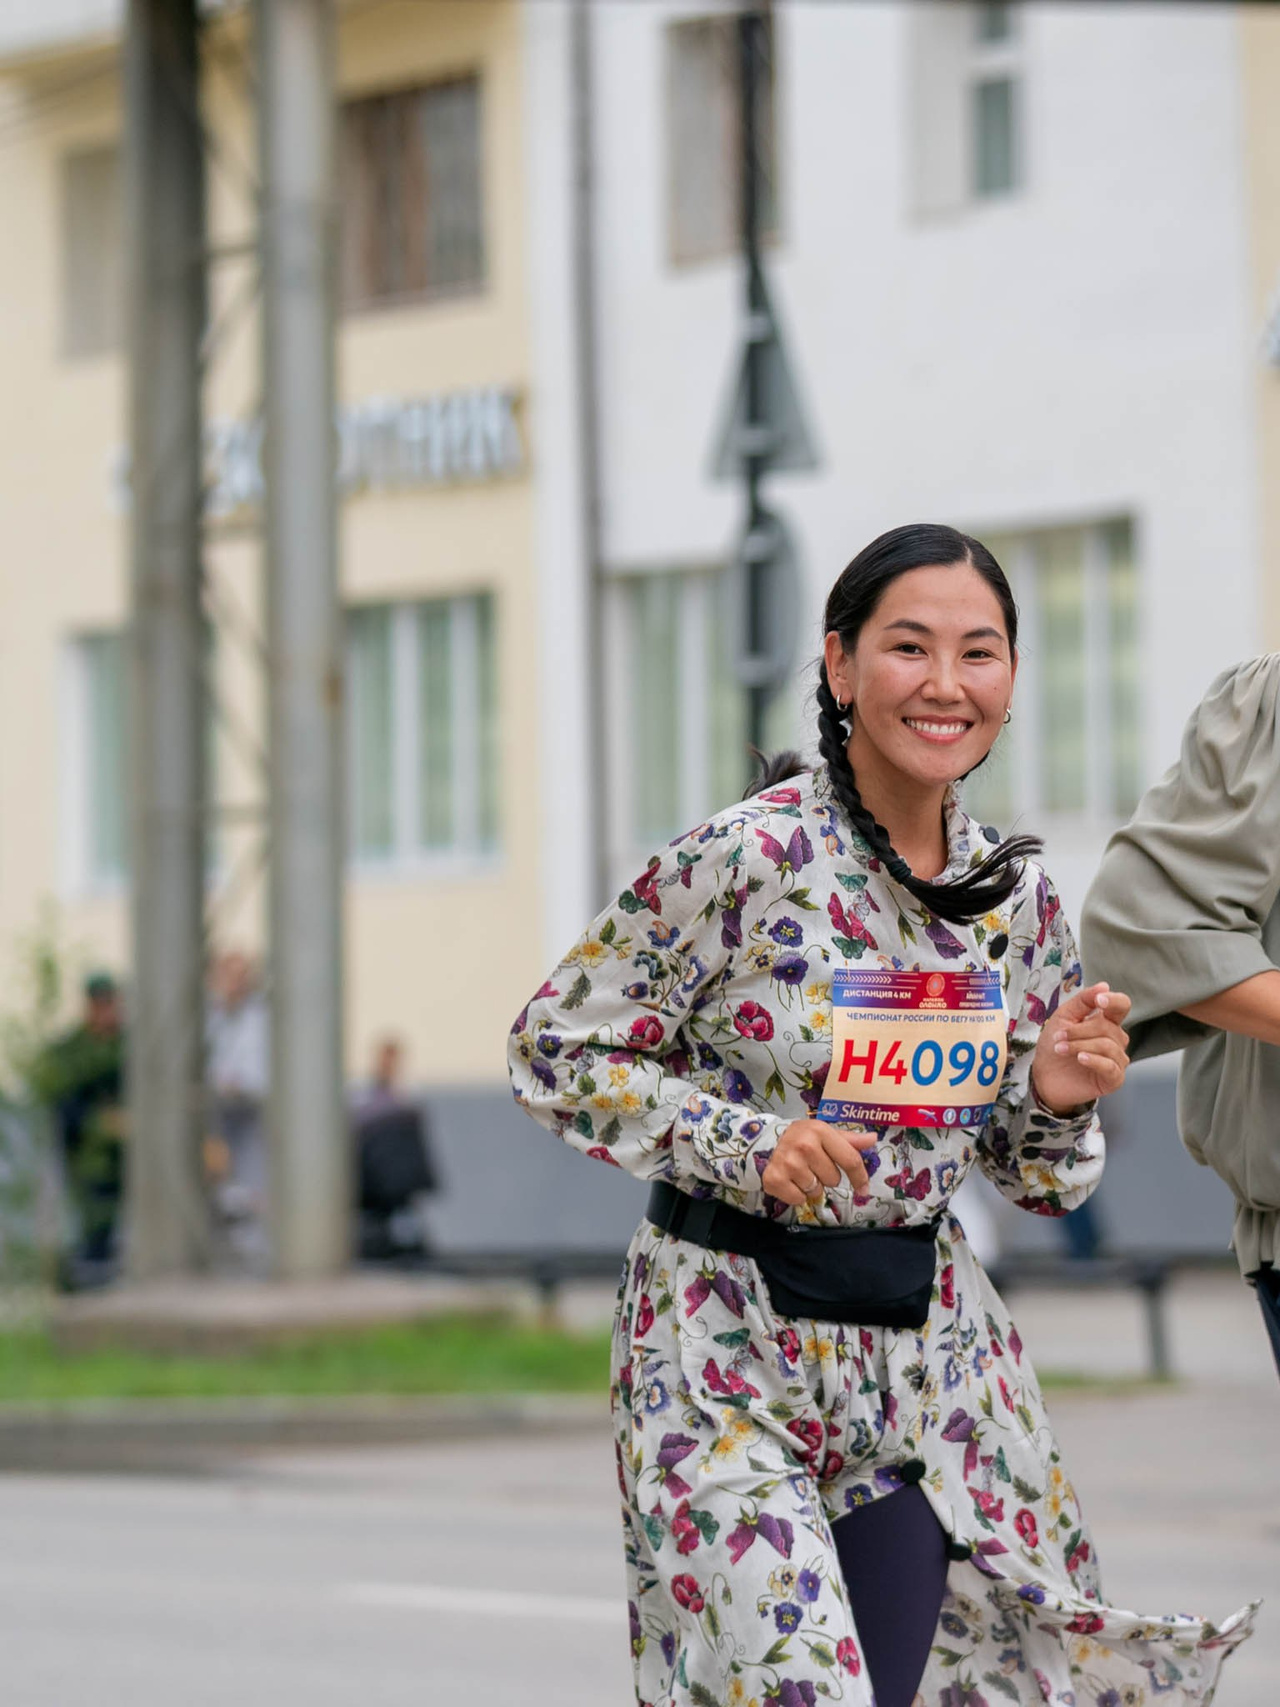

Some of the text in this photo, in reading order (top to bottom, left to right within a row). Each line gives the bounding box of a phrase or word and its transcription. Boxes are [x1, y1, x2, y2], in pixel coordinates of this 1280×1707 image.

[842, 989, 912, 1000] ДИСТАНЦИЯ 4 КМ
[847, 1012, 902, 1023] ЧЕМПИОНАТ
[903, 1014, 935, 1023] РОССИИ
[936, 1015, 950, 1023] ПО
[951, 1015, 968, 1023] БЕГУ
[985, 1014, 996, 1022] КМ
[840, 1104, 901, 1122] Skintime
